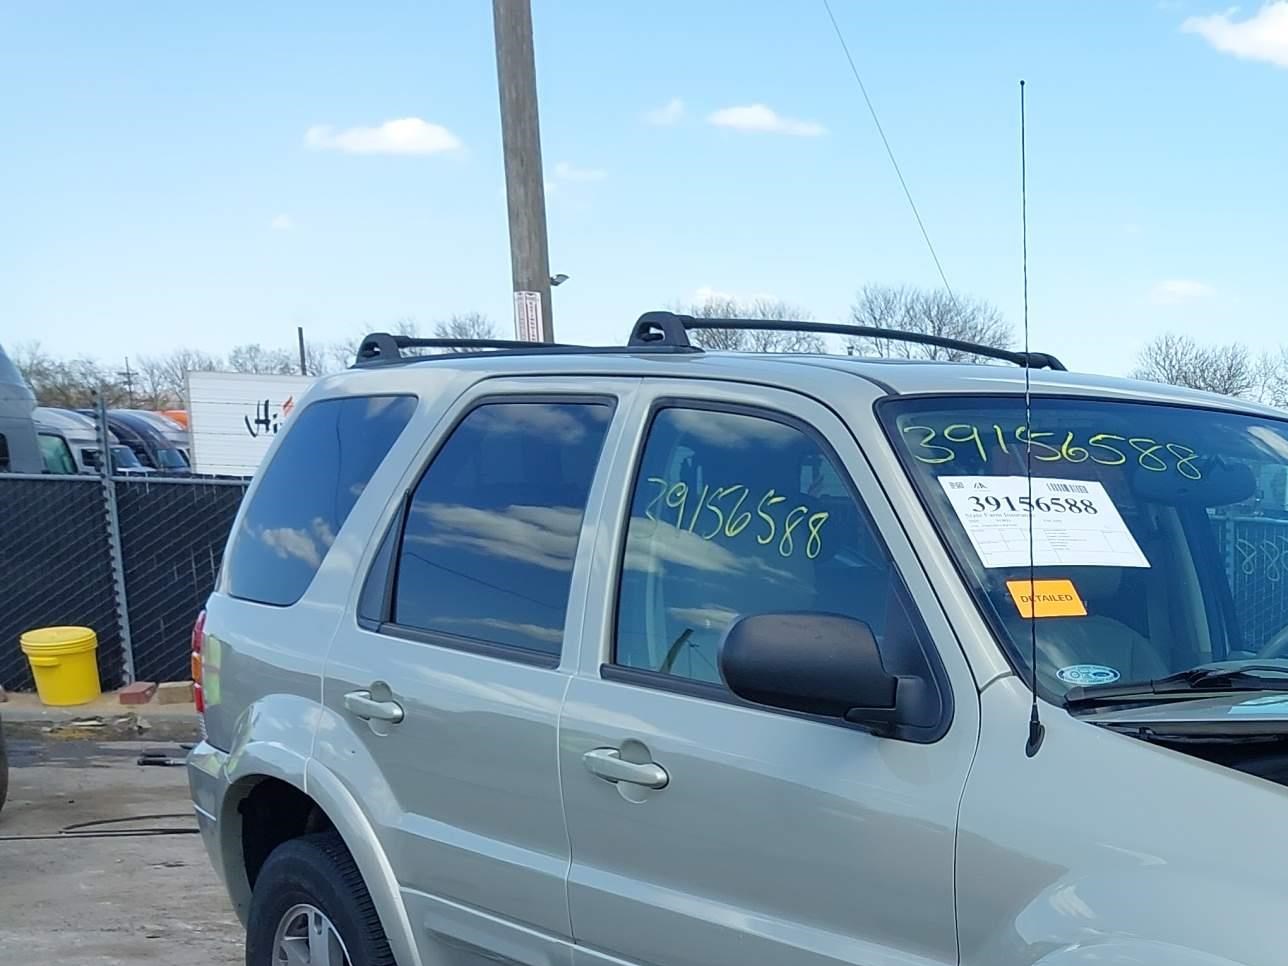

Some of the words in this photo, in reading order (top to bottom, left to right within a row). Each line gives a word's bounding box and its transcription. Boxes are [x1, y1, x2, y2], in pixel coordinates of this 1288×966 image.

[902, 424, 1203, 480] 39156588
[638, 477, 829, 560] 39156588
[968, 495, 1098, 515] 39156588
[1020, 593, 1074, 603] DETAILED
